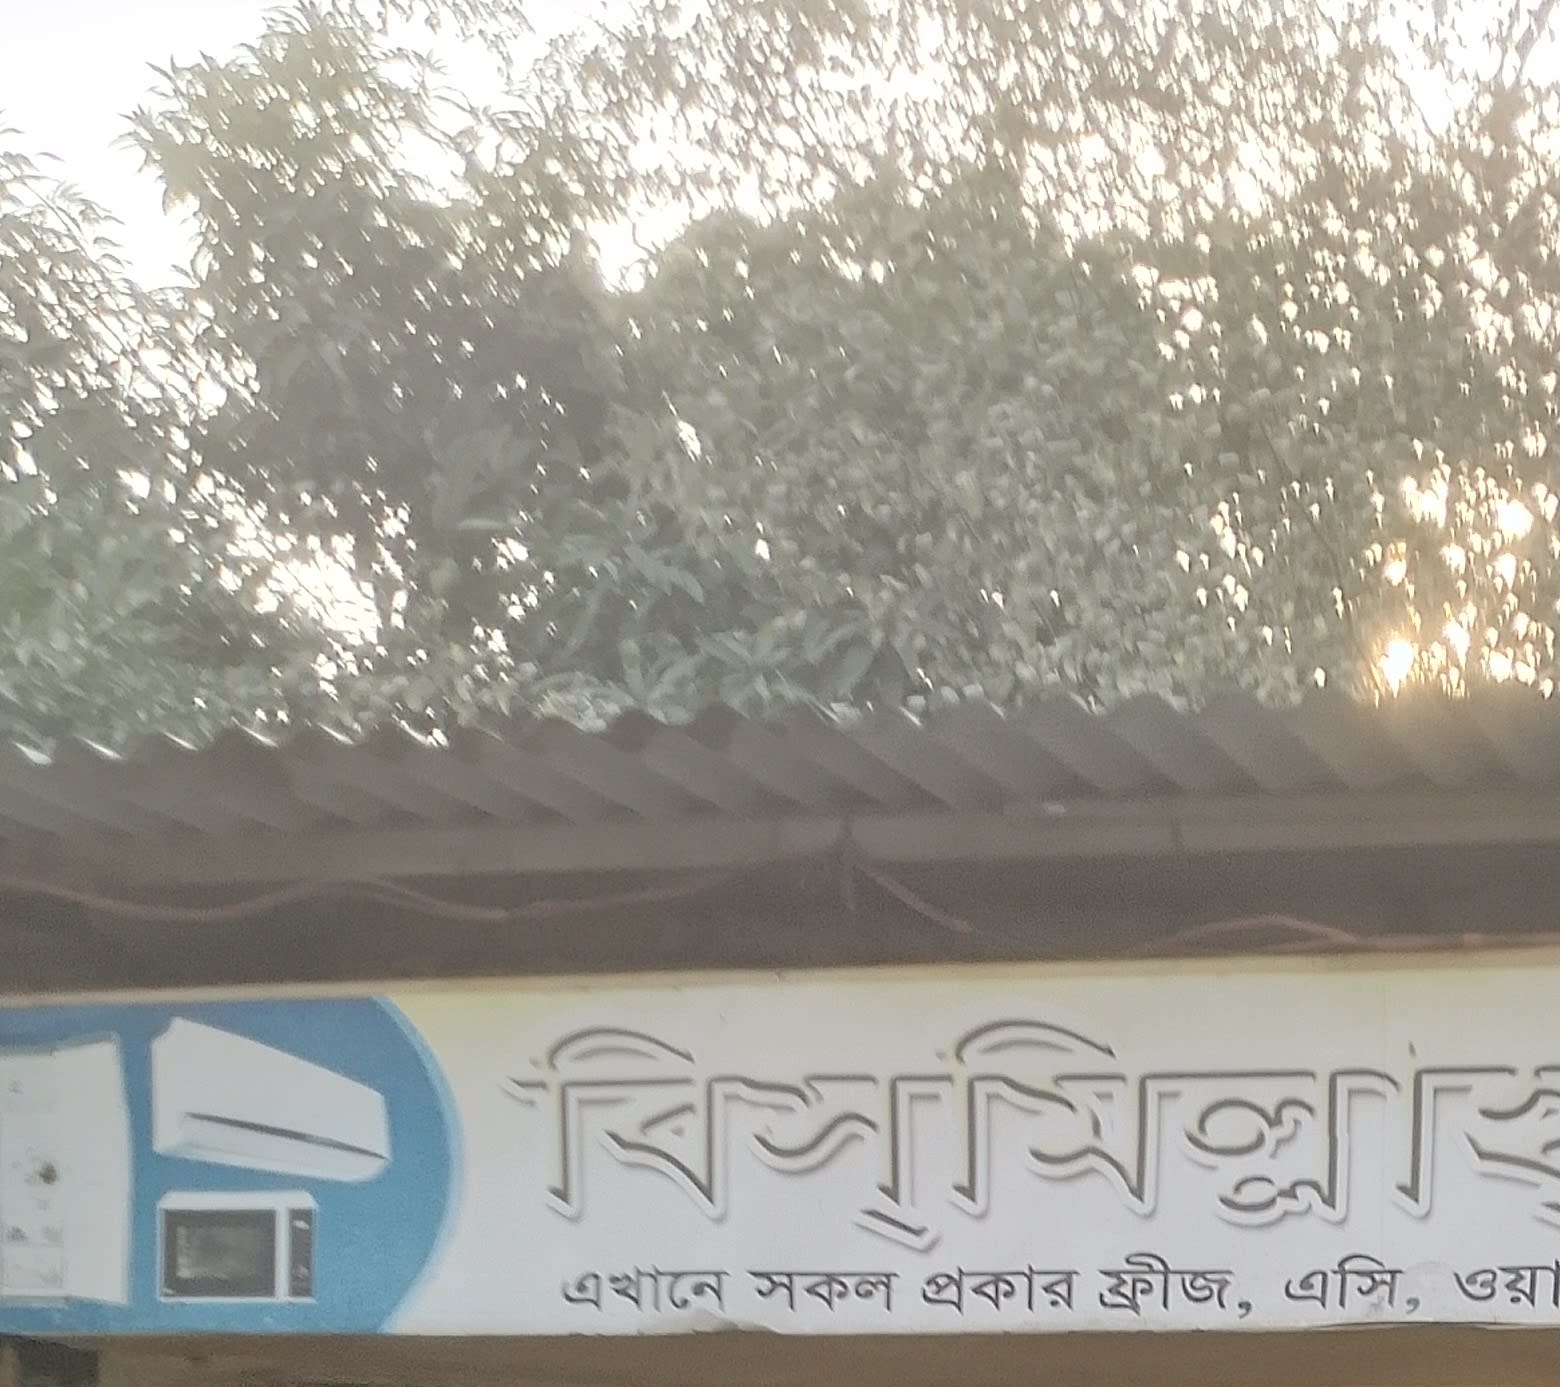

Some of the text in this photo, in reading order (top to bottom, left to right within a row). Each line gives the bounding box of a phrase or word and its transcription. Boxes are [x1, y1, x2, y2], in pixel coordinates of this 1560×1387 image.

[563, 1265, 729, 1313] এখানে
[746, 1270, 899, 1313] সকল
[922, 1264, 1079, 1313] প্রকার
[1099, 1252, 1251, 1318] ফ্রীজ,
[1285, 1254, 1420, 1314] এসি,
